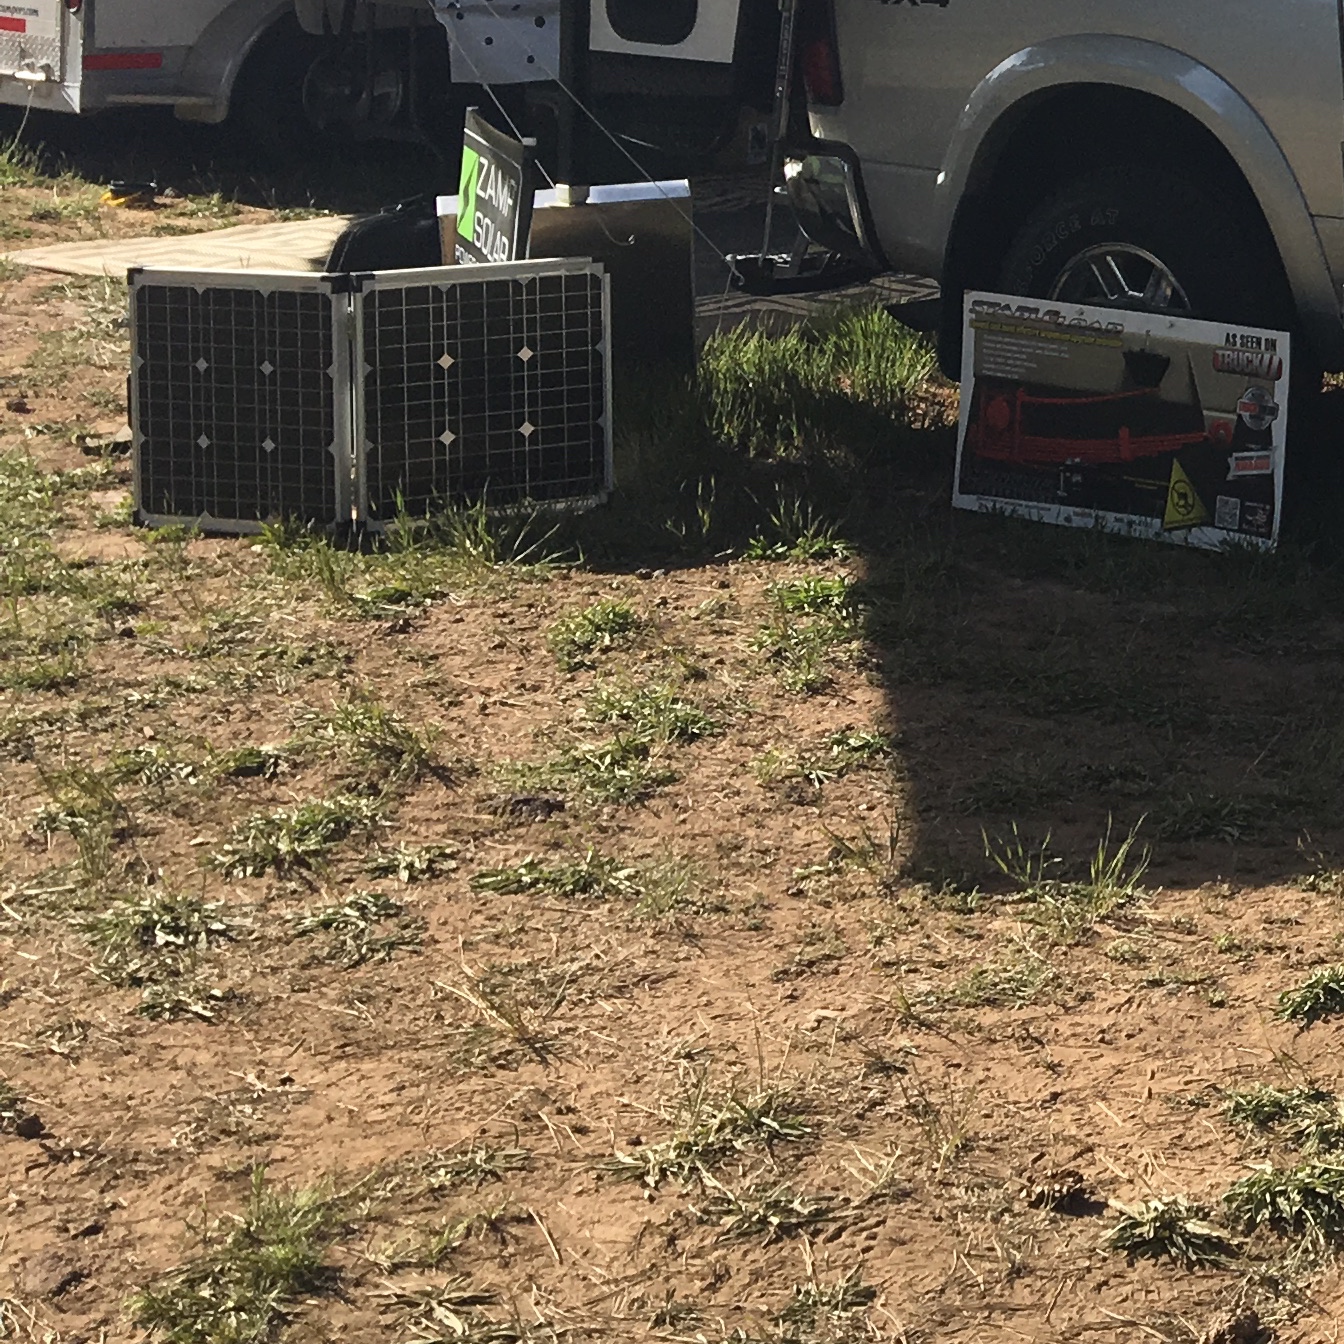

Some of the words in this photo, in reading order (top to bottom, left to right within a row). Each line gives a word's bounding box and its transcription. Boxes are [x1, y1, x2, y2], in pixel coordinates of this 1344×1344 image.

[1224, 332, 1238, 348] AS
[1239, 333, 1262, 350] SEEN
[1264, 337, 1277, 353] ON
